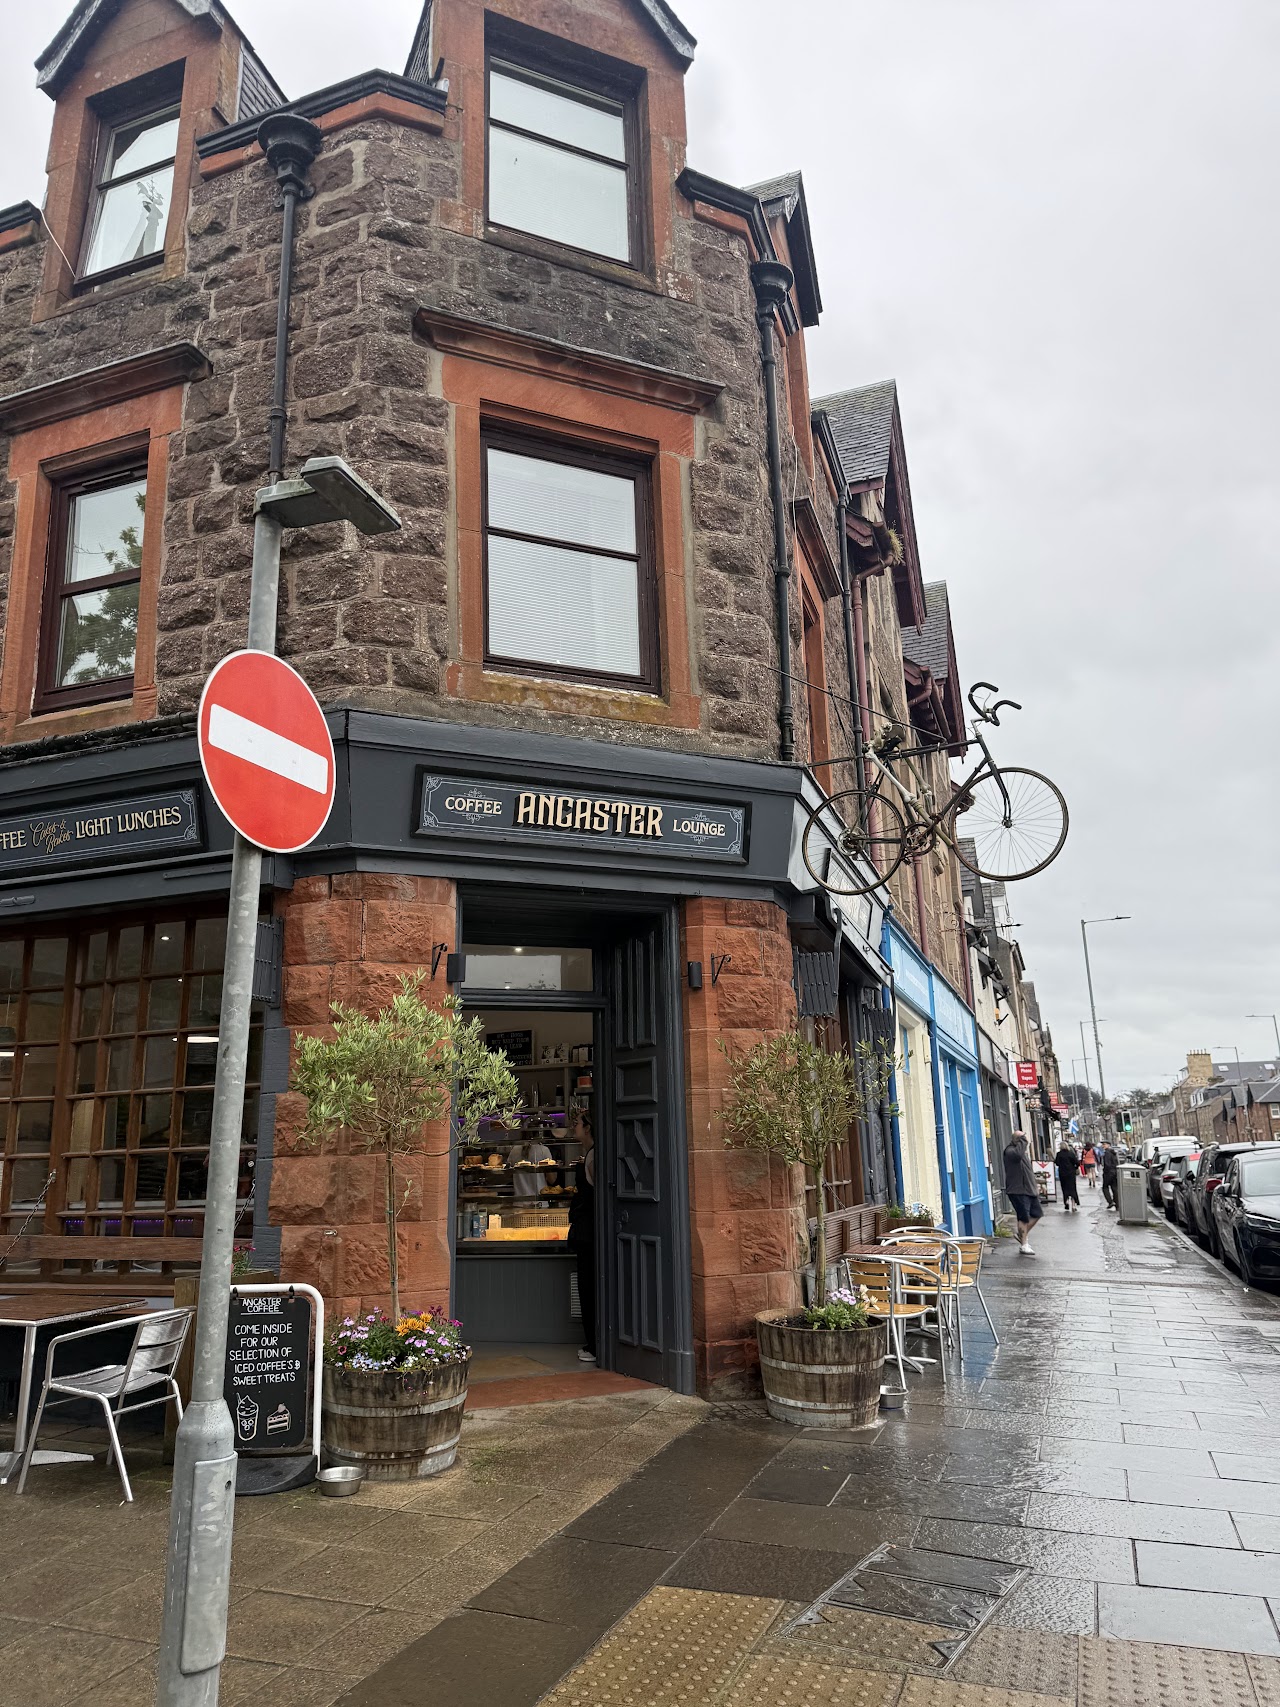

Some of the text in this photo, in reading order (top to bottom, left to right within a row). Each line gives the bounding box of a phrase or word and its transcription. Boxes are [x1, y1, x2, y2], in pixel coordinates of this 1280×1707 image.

[445, 792, 726, 838] COFFEE ANCASTER LOUNGE
[75, 806, 182, 839] LIGHT LUNCHES
[29, 821, 59, 847] Cakes
[46, 830, 73, 854] Bakes
[242, 1298, 281, 1306] ANCASTER
[234, 1322, 293, 1336] COME INSIDE
[240, 1336, 279, 1348] FOR OUR
[229, 1347, 292, 1361] SELECTION OF
[234, 1362, 255, 1374] ICED
[256, 1360, 294, 1372] COFFEE'S
[232, 1372, 296, 1386] SWEET TREATS
